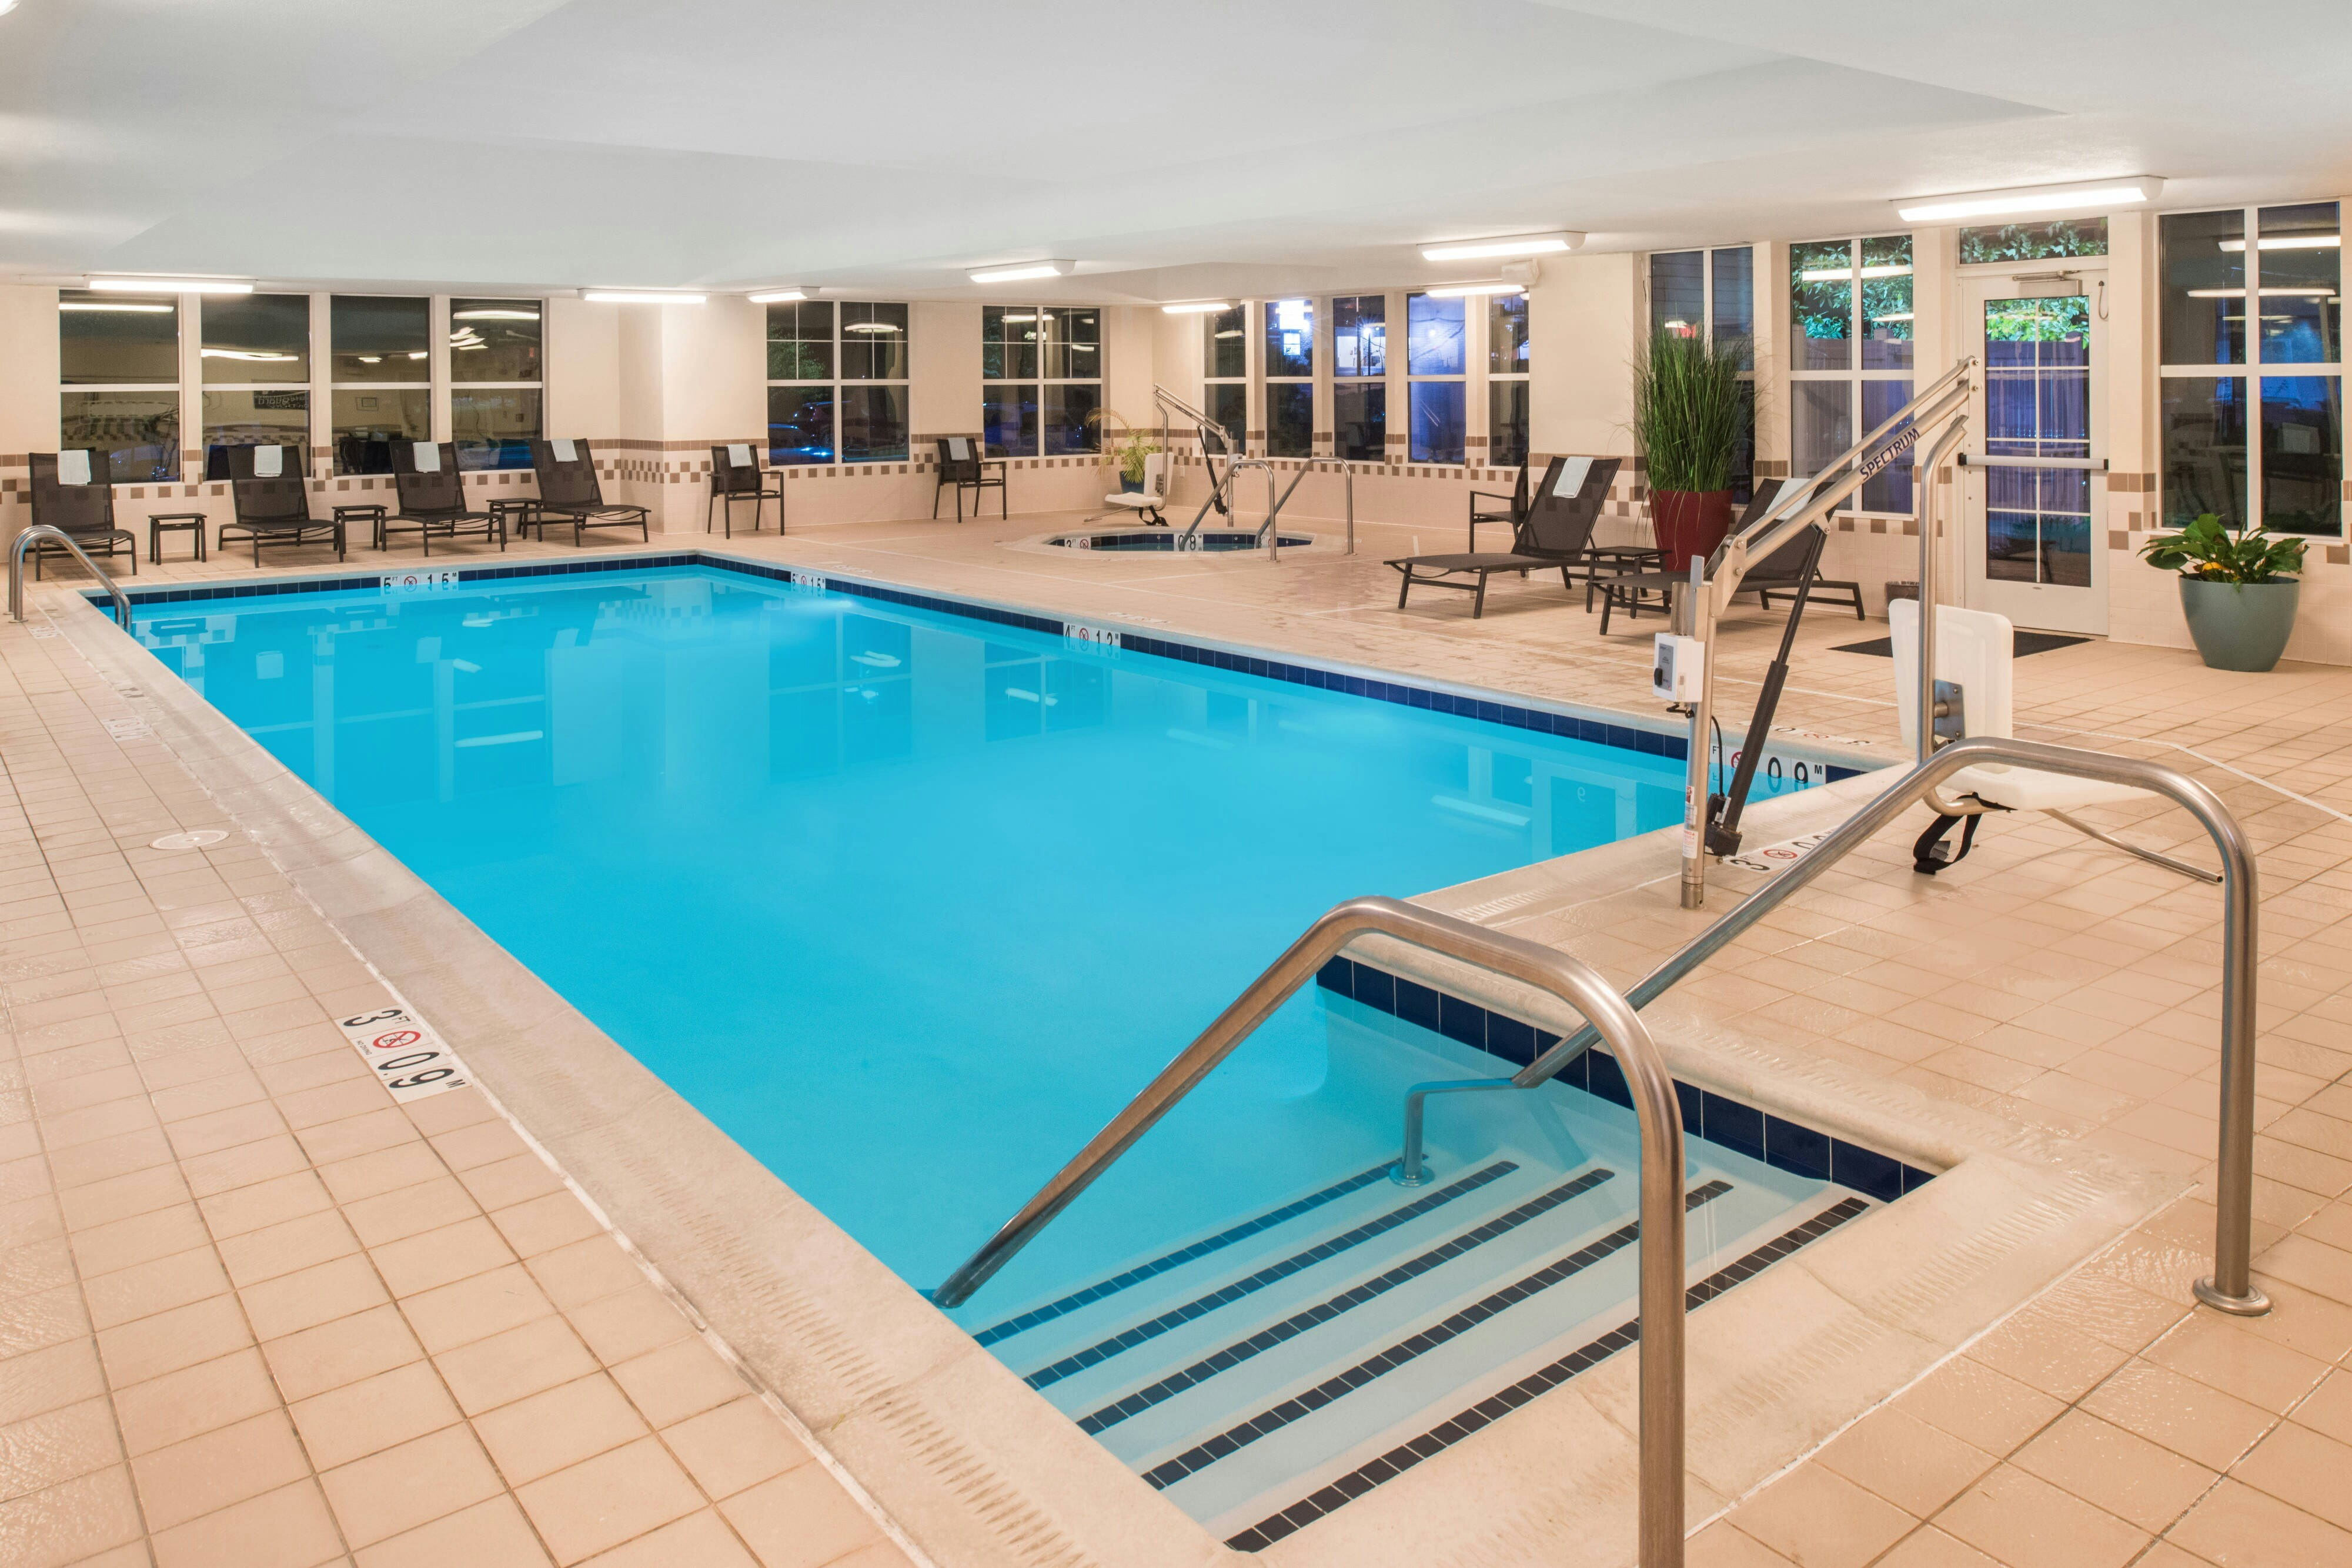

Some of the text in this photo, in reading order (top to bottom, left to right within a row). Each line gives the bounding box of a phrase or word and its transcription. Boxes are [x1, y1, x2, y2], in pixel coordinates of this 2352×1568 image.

[1860, 427, 1920, 481] SPECTRUM
[384, 577, 392, 587] 5
[1814, 764, 1822, 775] M
[1729, 859, 1770, 871] 3
[343, 1009, 411, 1027] 3 FT
[445, 1079, 466, 1088] M
